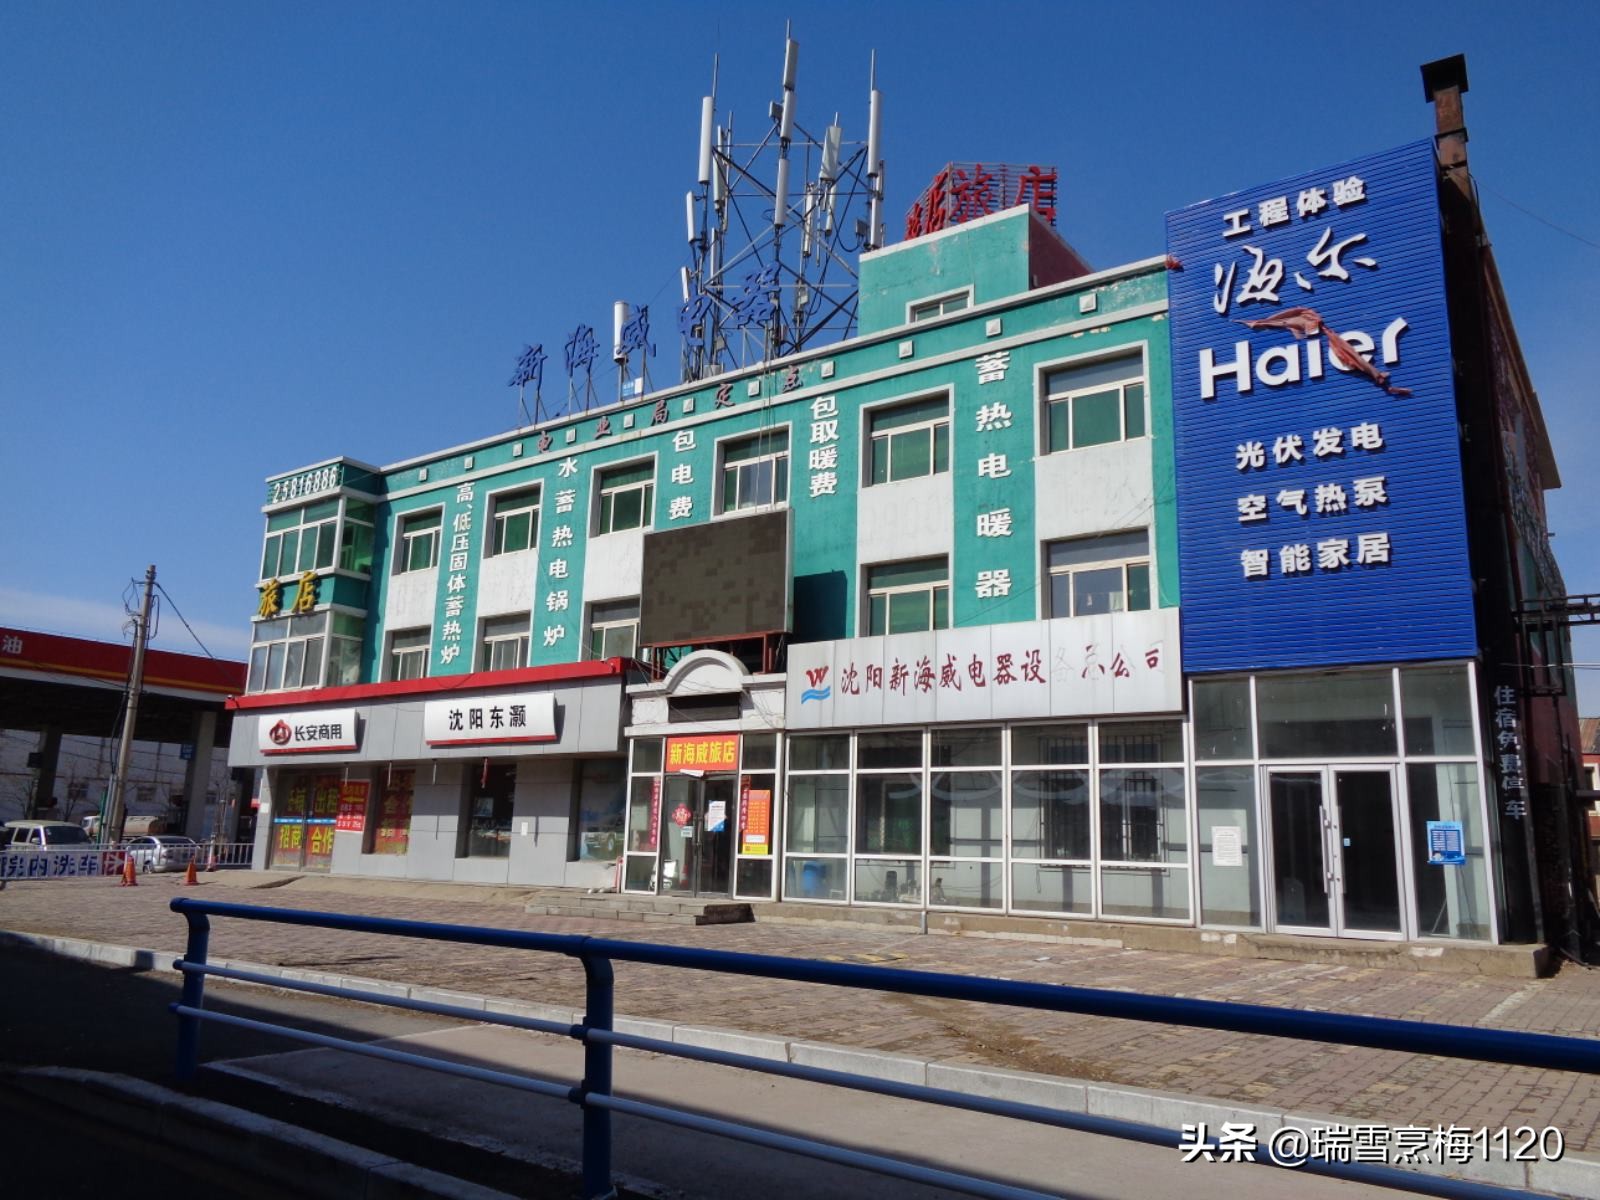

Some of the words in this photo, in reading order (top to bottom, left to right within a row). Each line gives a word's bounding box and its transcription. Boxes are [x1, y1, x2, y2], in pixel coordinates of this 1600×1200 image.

[951, 163, 1057, 225] 旅店
[1222, 175, 1366, 237] 工程体验
[1213, 226, 1377, 314] 海尔
[808, 395, 840, 499] 包取暖费
[1235, 422, 1384, 470] 光伏发电
[272, 466, 338, 504] 25816886
[669, 430, 697, 521] 包电费
[974, 350, 1013, 600] 蓄热电暖器
[1237, 476, 1388, 523] 空气热泵
[440, 481, 475, 665] 高、低压固体蓄热炉
[543, 456, 578, 647] 水蓄热电锅炉
[1240, 533, 1391, 578] 智能家居
[258, 570, 318, 618] 旅店
[294, 723, 343, 742] 长安商用
[448, 704, 527, 731] 沈阳东灏
[669, 740, 736, 766] 新海威旅店
